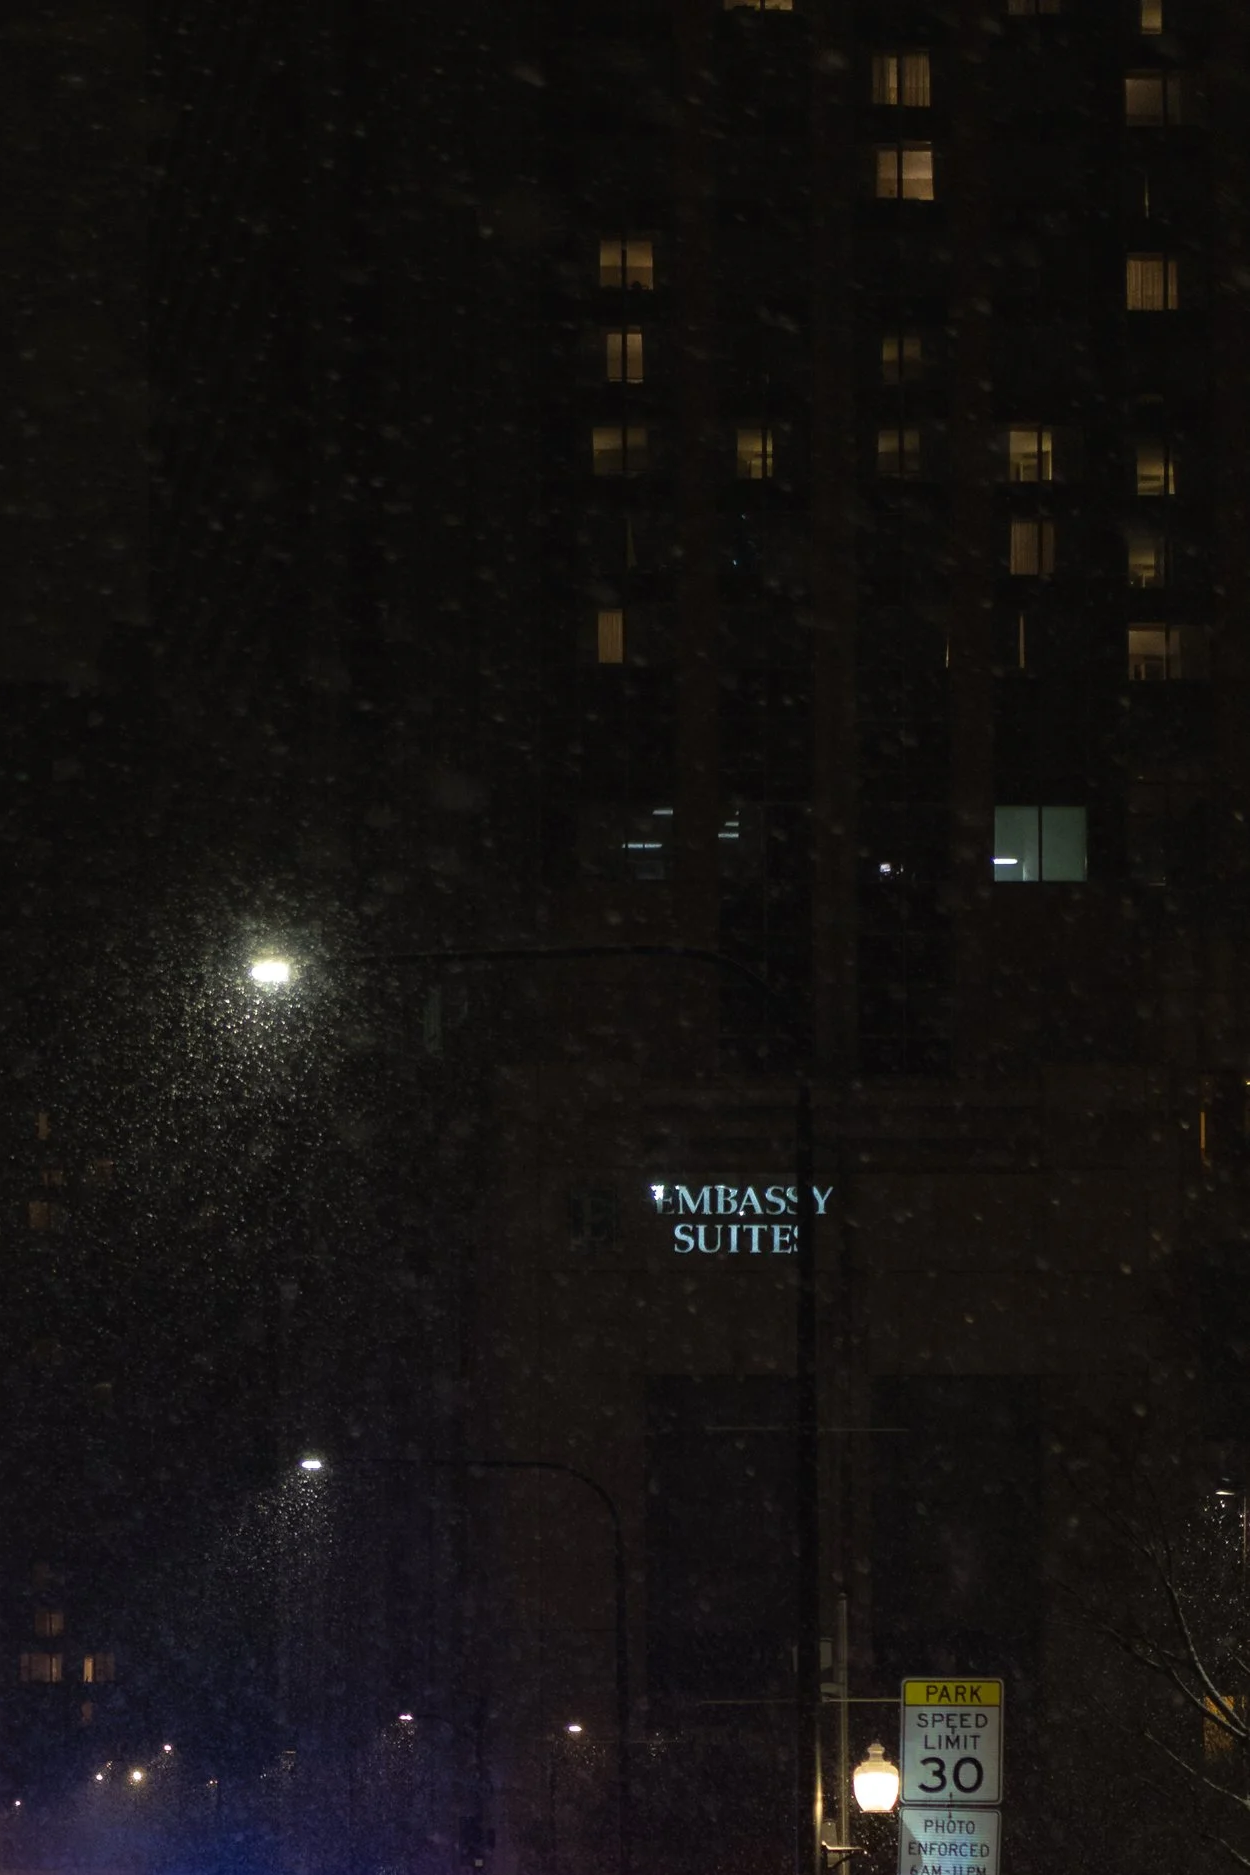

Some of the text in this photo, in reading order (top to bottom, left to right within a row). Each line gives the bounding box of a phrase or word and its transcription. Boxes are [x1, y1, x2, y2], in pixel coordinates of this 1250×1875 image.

[673, 1223, 799, 1254] SUITE
[925, 1684, 983, 1703] PARK
[917, 1712, 988, 1729] SPEED
[924, 1734, 981, 1751] LIMIT
[917, 1756, 984, 1794] 30
[924, 1819, 976, 1835] PHOTO
[908, 1842, 990, 1858] ENFORCED
